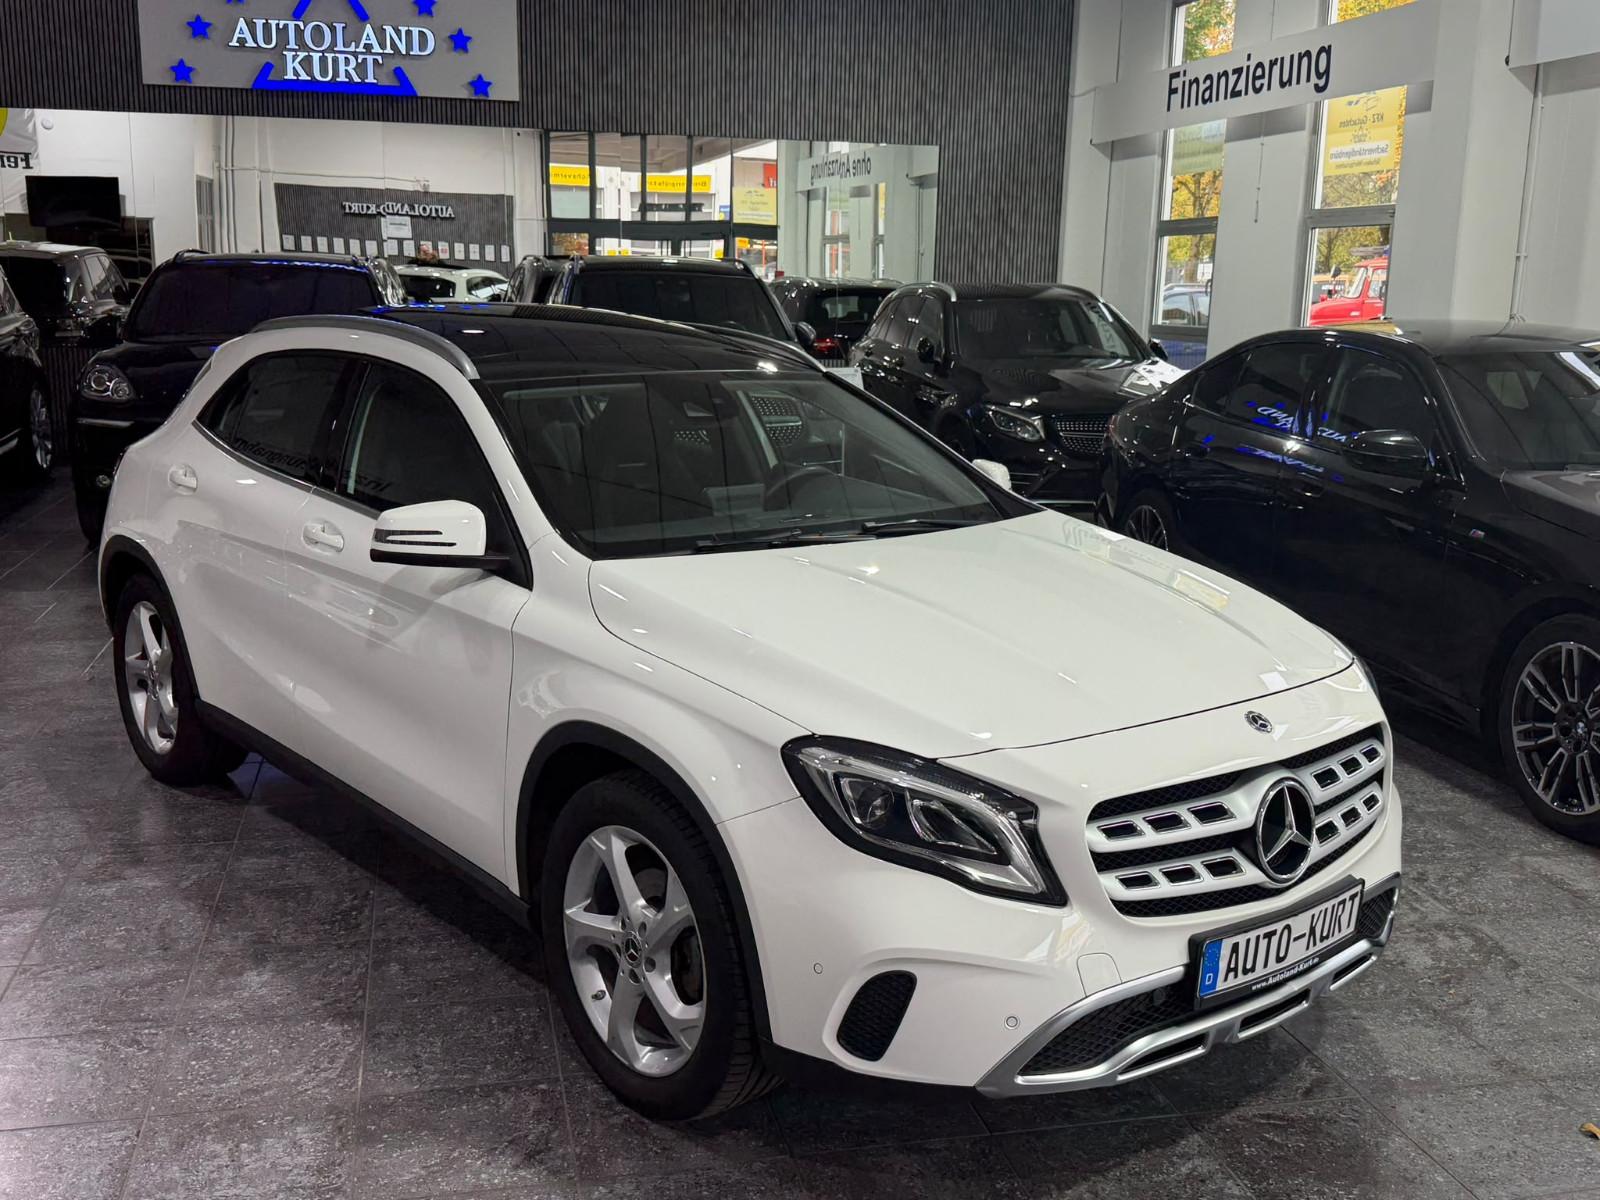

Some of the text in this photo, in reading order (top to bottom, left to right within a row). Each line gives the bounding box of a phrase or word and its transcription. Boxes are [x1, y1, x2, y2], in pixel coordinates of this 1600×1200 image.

[228, 17, 436, 56] AUTOLAND
[282, 51, 383, 84] KURT
[1166, 44, 1332, 112] Finanzierung
[1205, 890, 1360, 985] D AUTO-KURT
